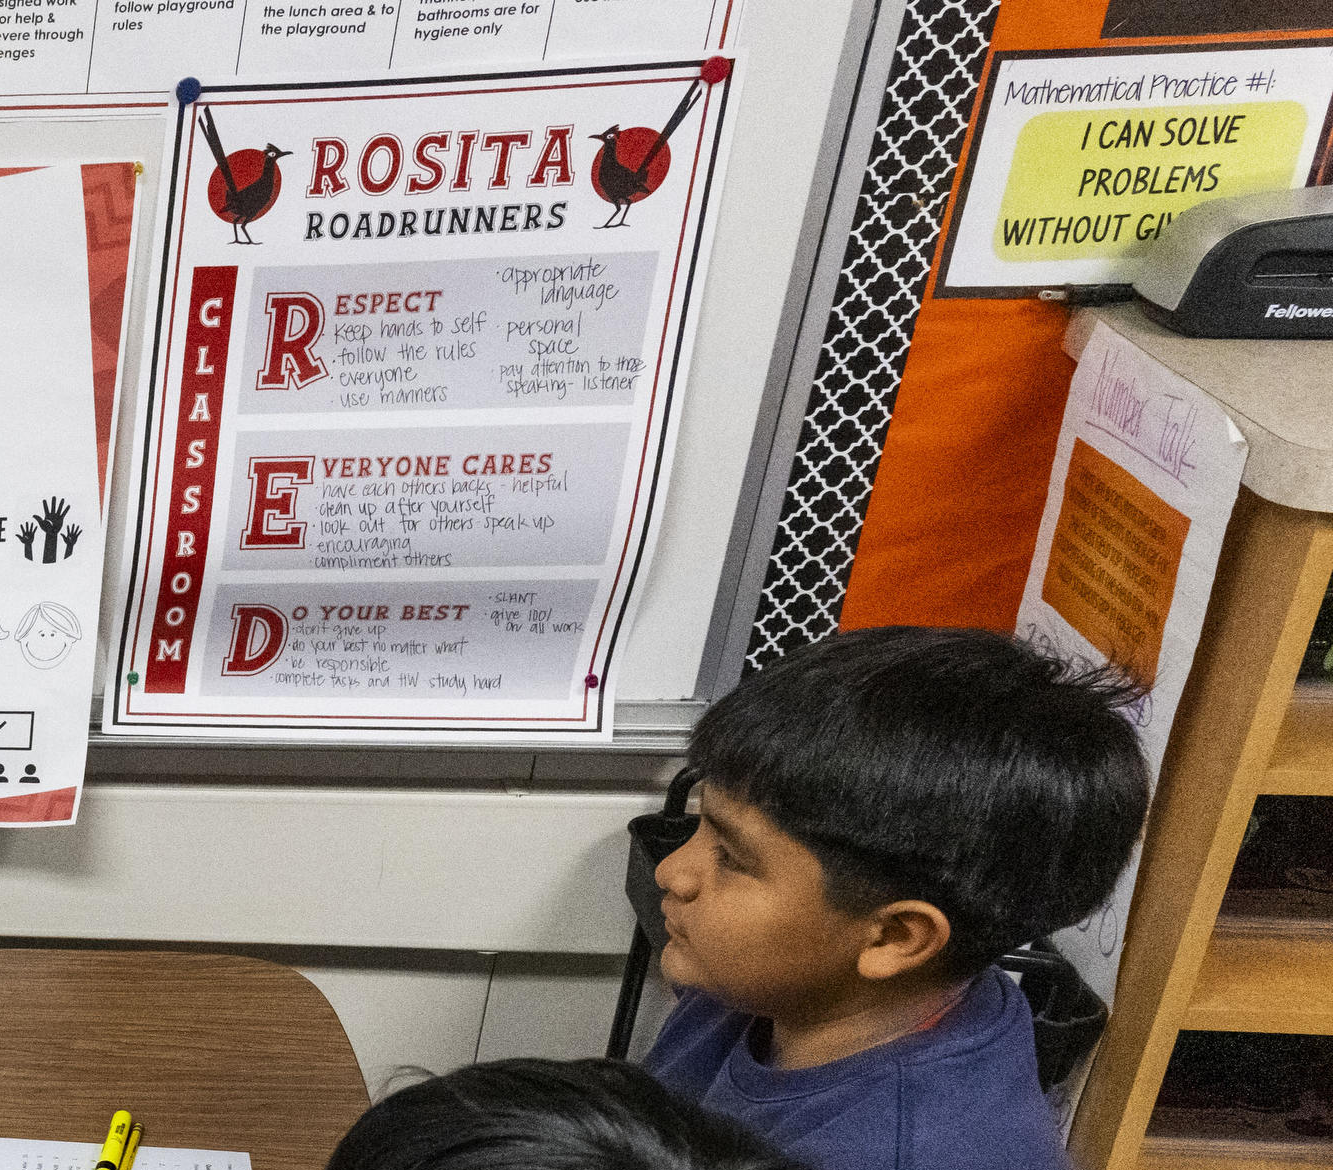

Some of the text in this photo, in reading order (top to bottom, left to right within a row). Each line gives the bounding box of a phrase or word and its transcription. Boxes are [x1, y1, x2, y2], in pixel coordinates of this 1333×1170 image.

[261, 20, 366, 37] the playground
[414, 22, 502, 40] hygiene only
[1005, 75, 1145, 105] Mathematical
[1150, 73, 1238, 100] Practice
[1099, 121, 1153, 149] CAN
[1160, 115, 1245, 146] SOLVE
[305, 124, 575, 198] ROSITA
[1078, 164, 1219, 197] PROBLEMS
[304, 202, 568, 240] ROADRUNNERS
[1003, 213, 1132, 246] WITHOUT
[1265, 304, 1333, 319] Fellowe
[334, 312, 487, 345] Keep hands to self
[462, 452, 553, 475] CARES
[315, 604, 393, 622] YOUR
[403, 603, 470, 621] BEST
